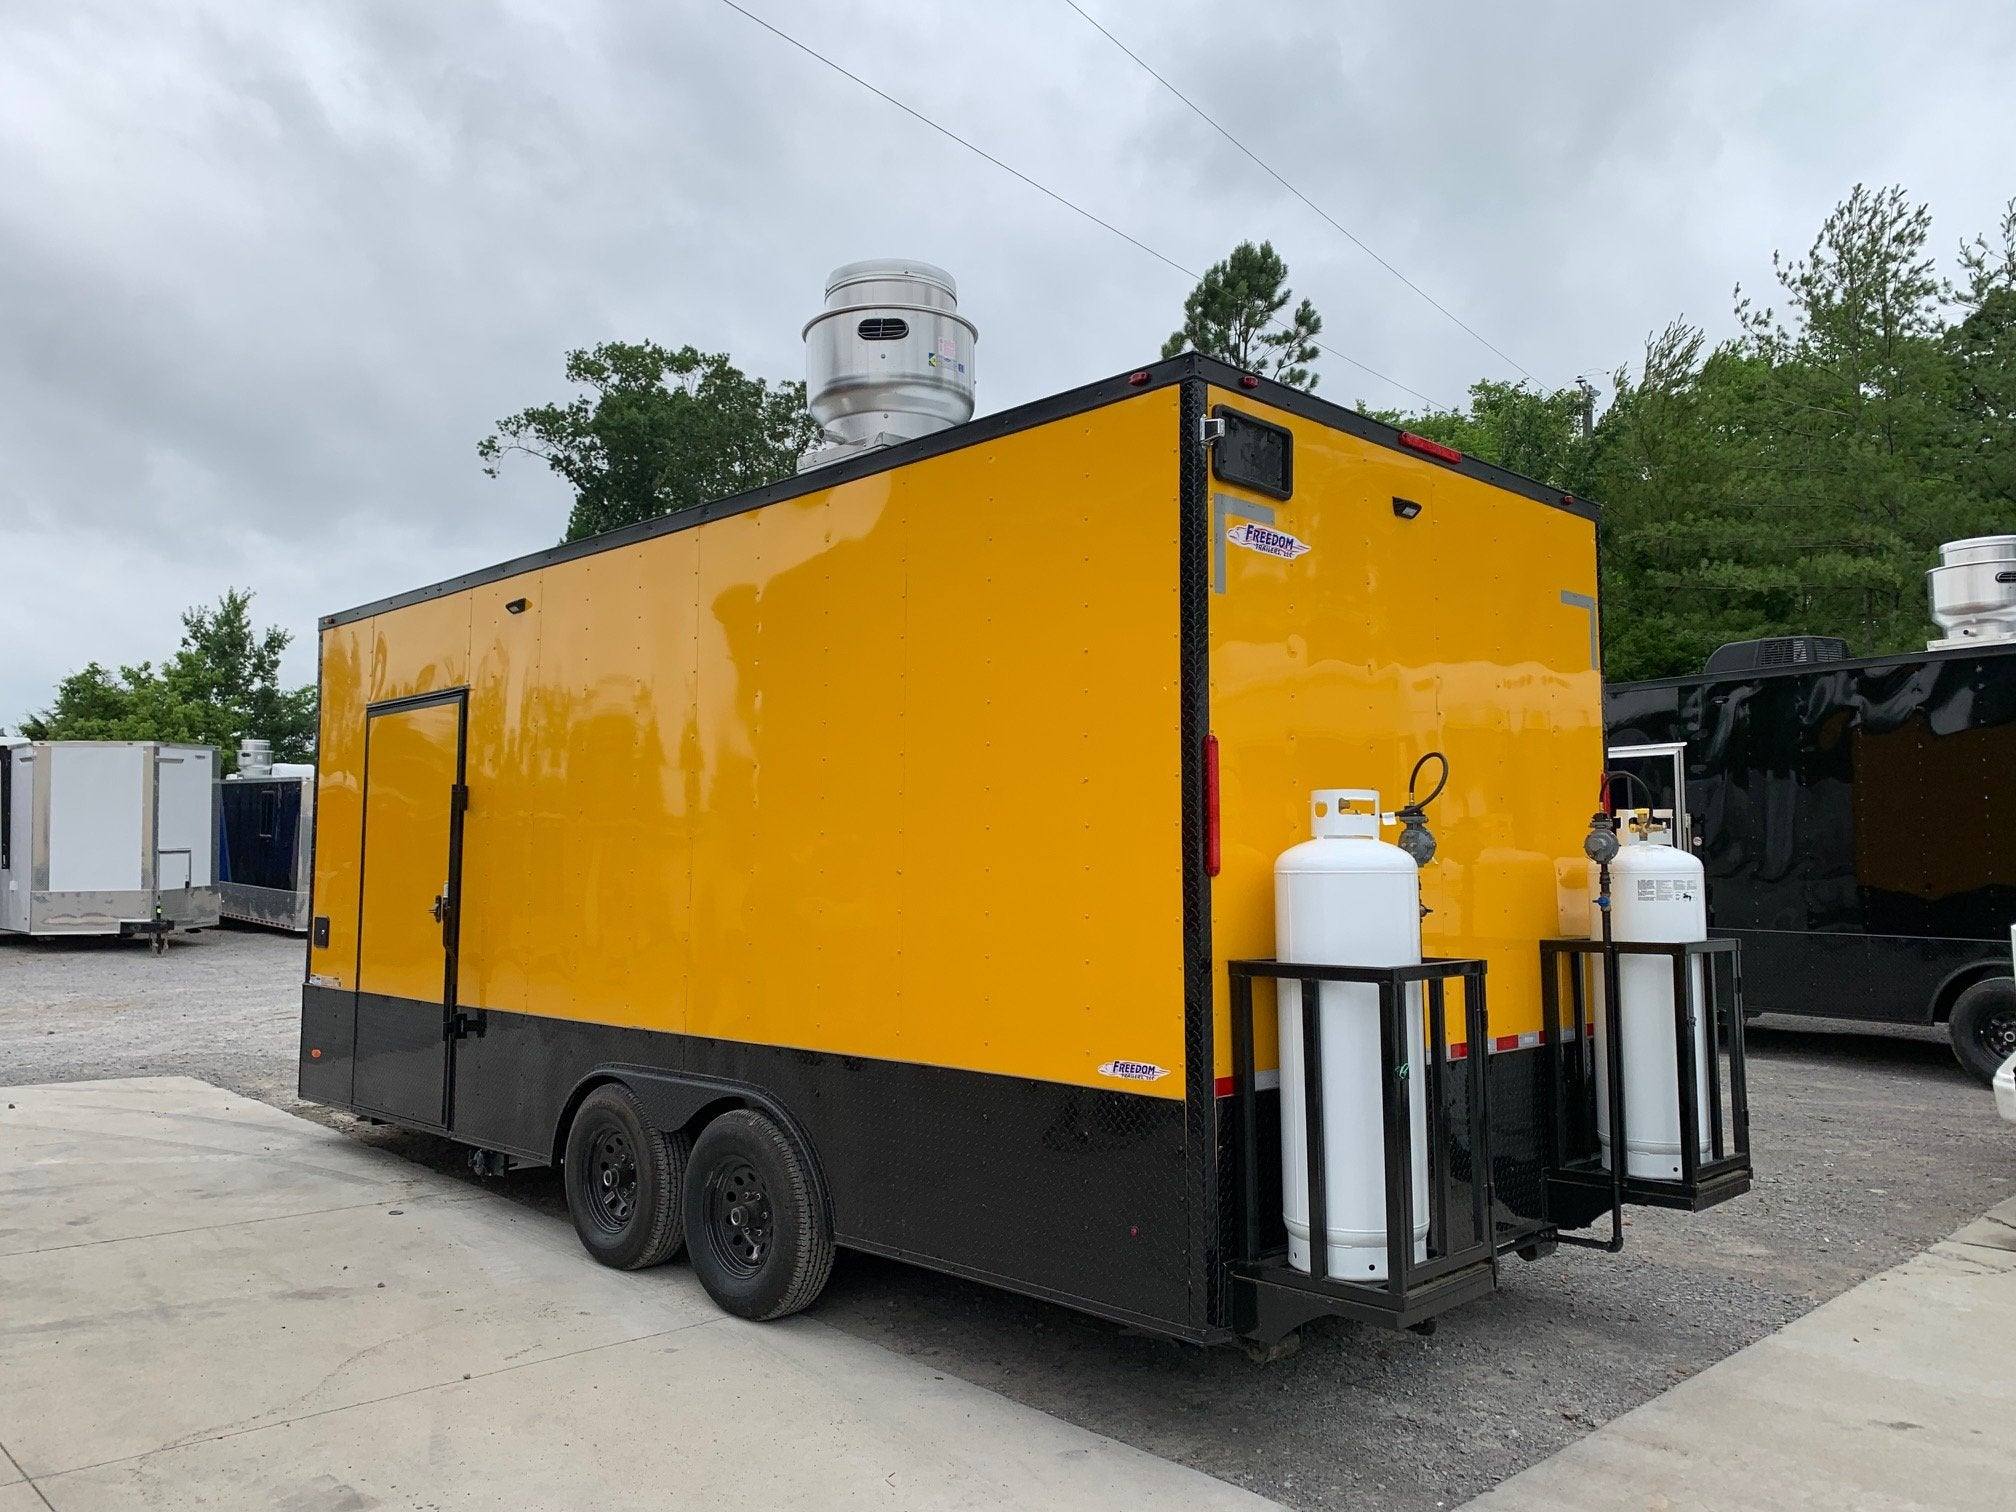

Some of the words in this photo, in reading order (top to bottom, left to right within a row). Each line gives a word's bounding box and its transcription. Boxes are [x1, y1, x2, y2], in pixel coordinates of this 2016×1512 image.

[1246, 524, 1294, 550] FREEDOM
[1283, 549, 1294, 558] LLC
[1113, 1060, 1156, 1075] FREEDOM
